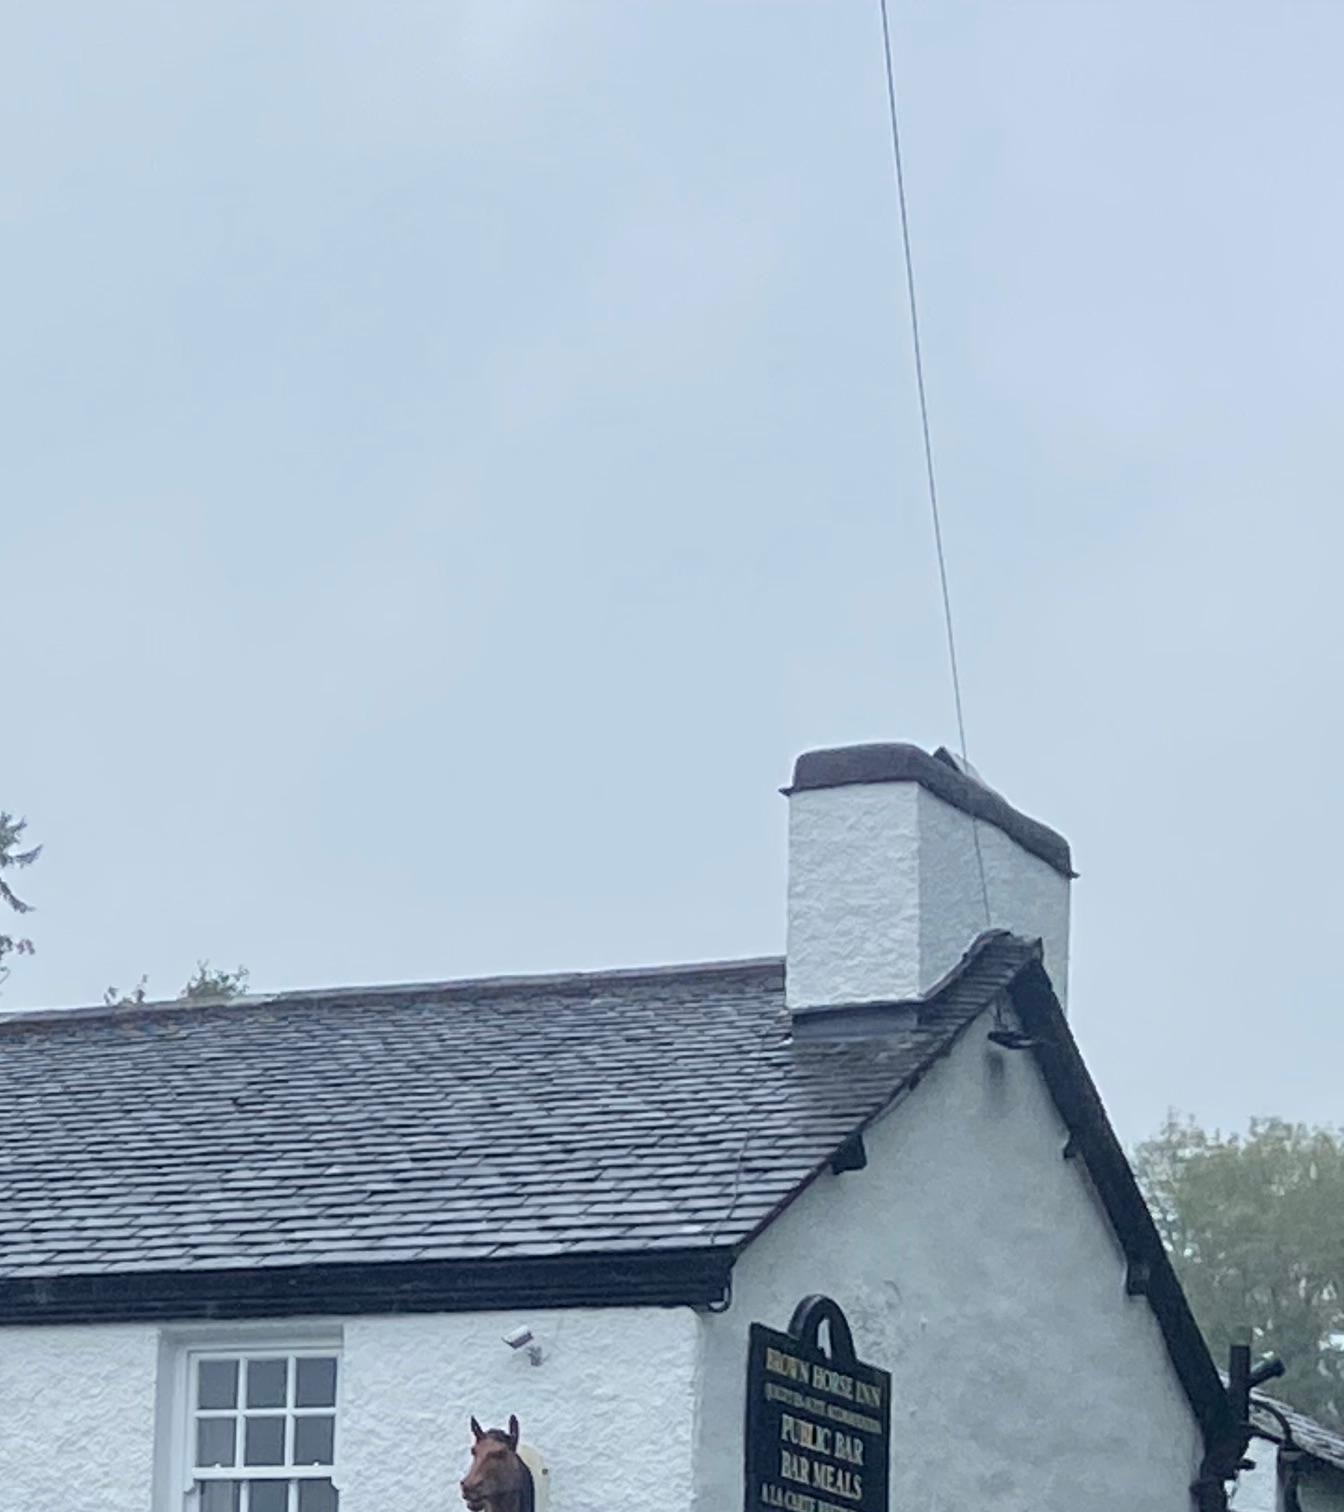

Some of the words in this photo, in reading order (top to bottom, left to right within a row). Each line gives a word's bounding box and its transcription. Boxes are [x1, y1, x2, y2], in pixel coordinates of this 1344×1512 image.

[812, 1365, 853, 1400] HORSE
[855, 1381, 881, 1408] INN
[781, 1413, 832, 1455] PUBLIC
[834, 1431, 864, 1466] BAR
[781, 1449, 810, 1485] BAR
[813, 1461, 863, 1500] MEALS
